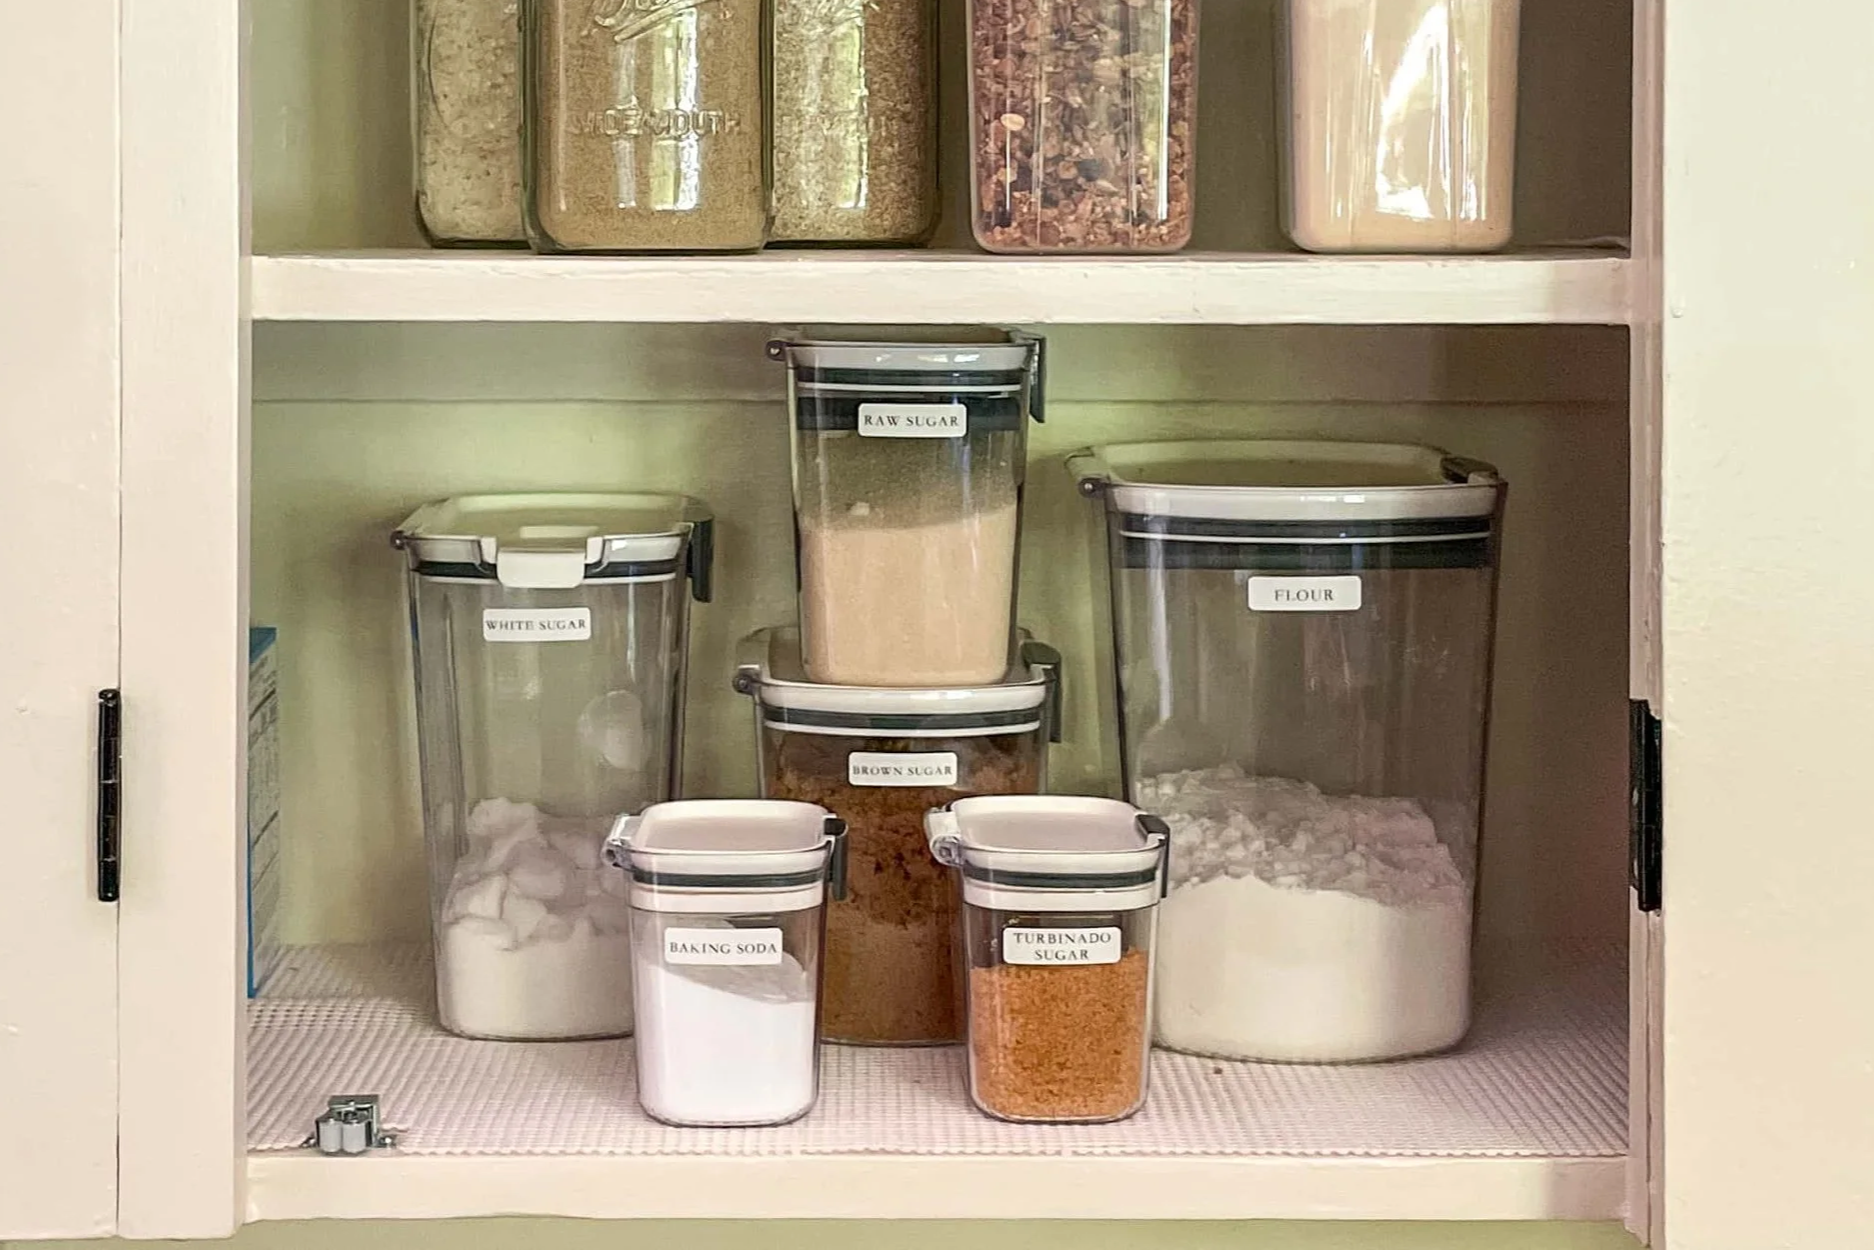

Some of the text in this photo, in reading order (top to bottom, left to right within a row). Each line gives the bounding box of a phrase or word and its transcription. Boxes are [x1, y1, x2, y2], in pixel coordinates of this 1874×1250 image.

[863, 414, 960, 427] RAW SUGAR
[1273, 588, 1334, 602] FLOUR
[484, 618, 587, 631] WHITE SUGAR
[851, 765, 953, 776] BROWN SUGAR
[1012, 931, 1113, 945] TURBINADO
[669, 941, 778, 955] BAKING SODA
[1033, 949, 1090, 962] SUGAR
